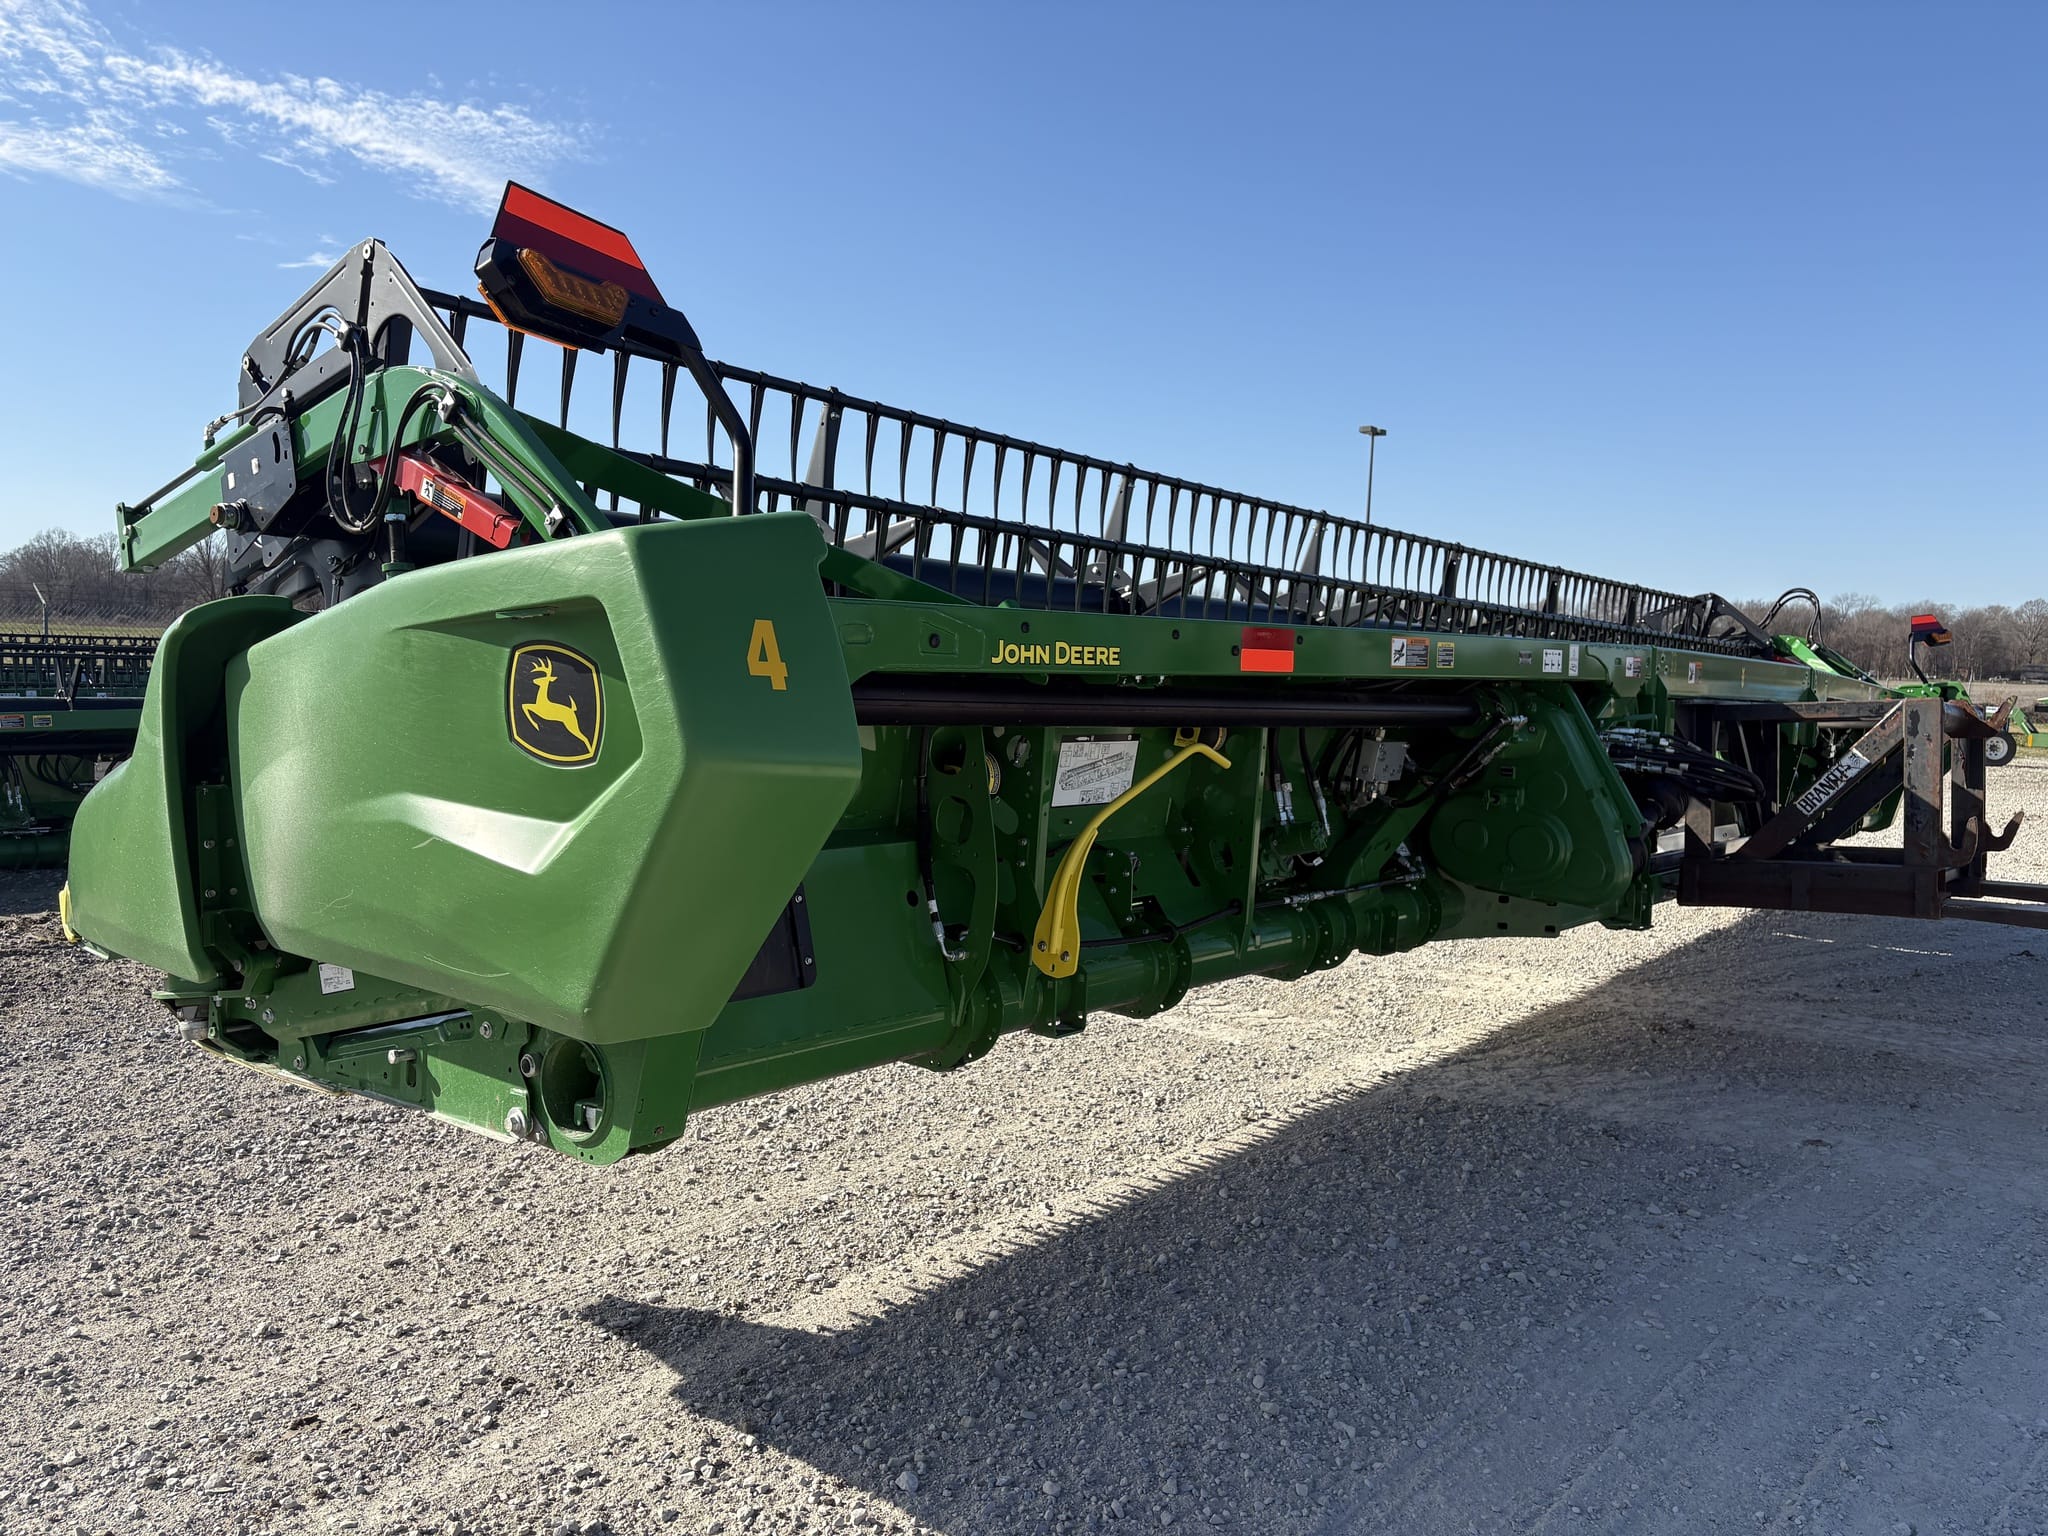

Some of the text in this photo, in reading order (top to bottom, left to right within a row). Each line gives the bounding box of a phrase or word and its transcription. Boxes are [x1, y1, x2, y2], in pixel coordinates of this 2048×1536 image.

[746, 618, 788, 691] 4
[991, 639, 1121, 666] JOHN DEERE
